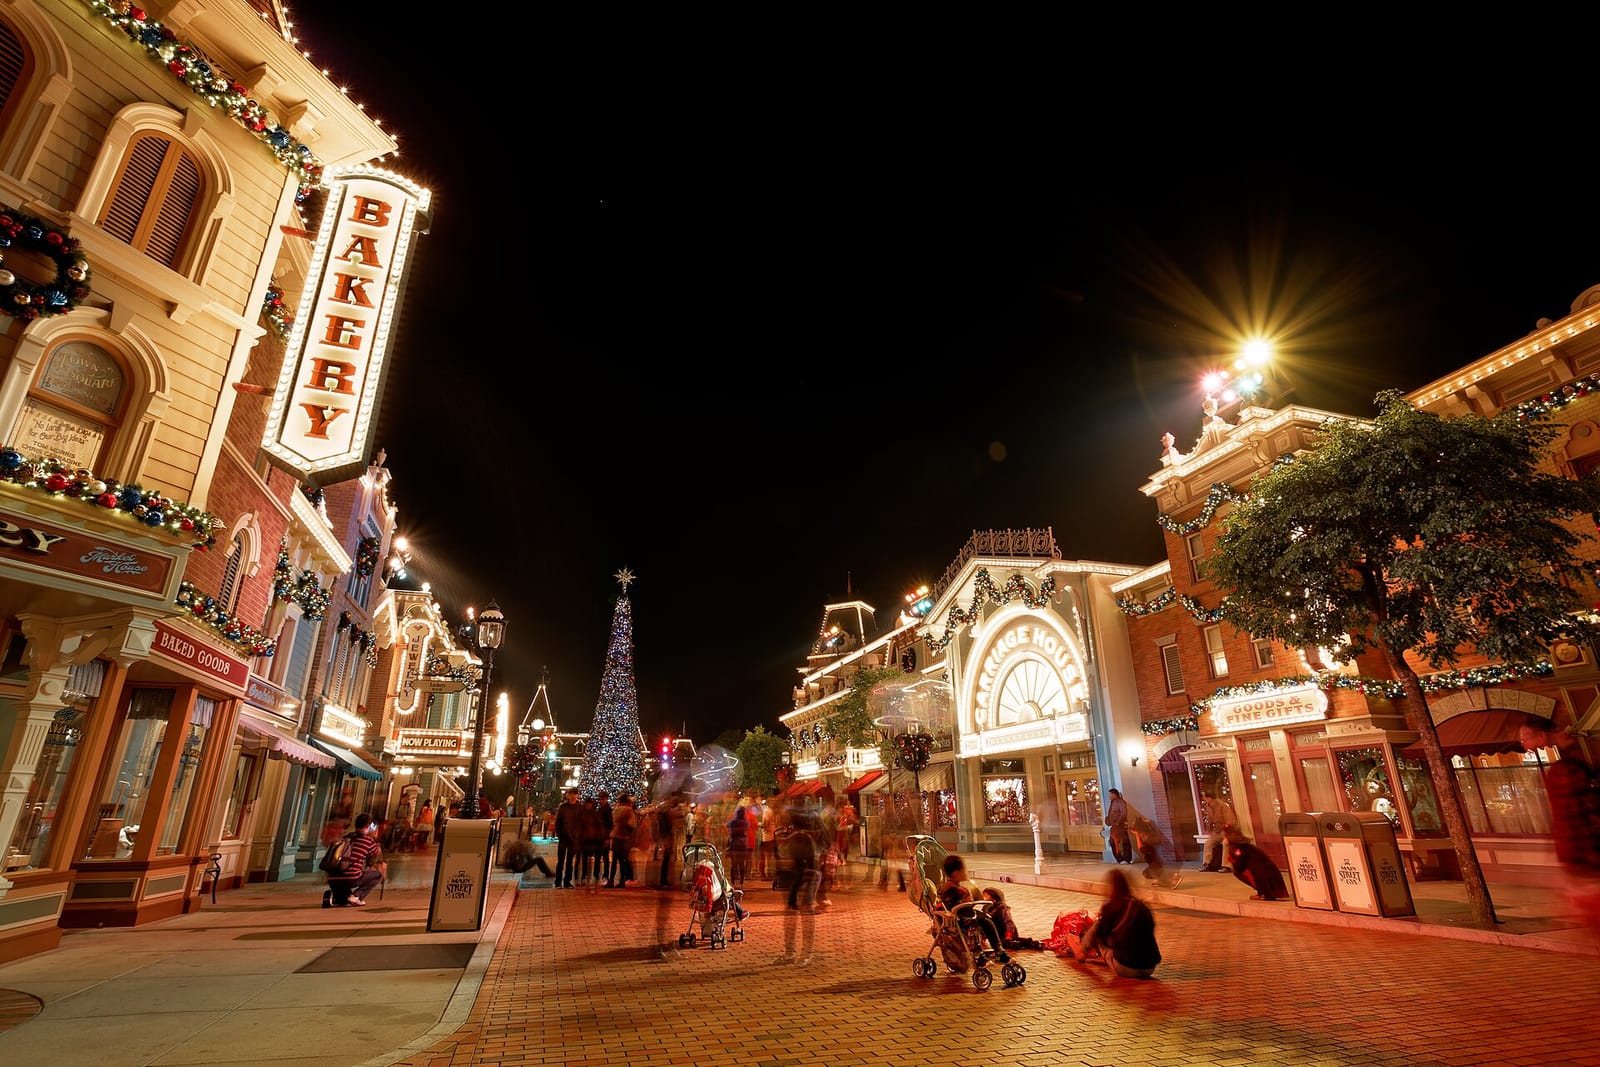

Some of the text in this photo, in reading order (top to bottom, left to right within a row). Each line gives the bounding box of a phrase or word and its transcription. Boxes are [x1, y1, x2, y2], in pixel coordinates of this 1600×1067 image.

[299, 195, 392, 440] BAKERY
[80, 547, 138, 564] Market
[102, 560, 149, 575] House
[160, 632, 231, 676] BAKED GOODS
[1031, 626, 1084, 705] HOUSE
[974, 626, 1031, 727] CARRIAGE
[1226, 703, 1315, 724] FINE GIFTS
[1233, 696, 1302, 714] GOODS &
[402, 737, 457, 749] NOW PLAYING
[1298, 868, 1318, 880] STREET
[1339, 870, 1361, 883] STREET
[445, 883, 473, 897] STREET
